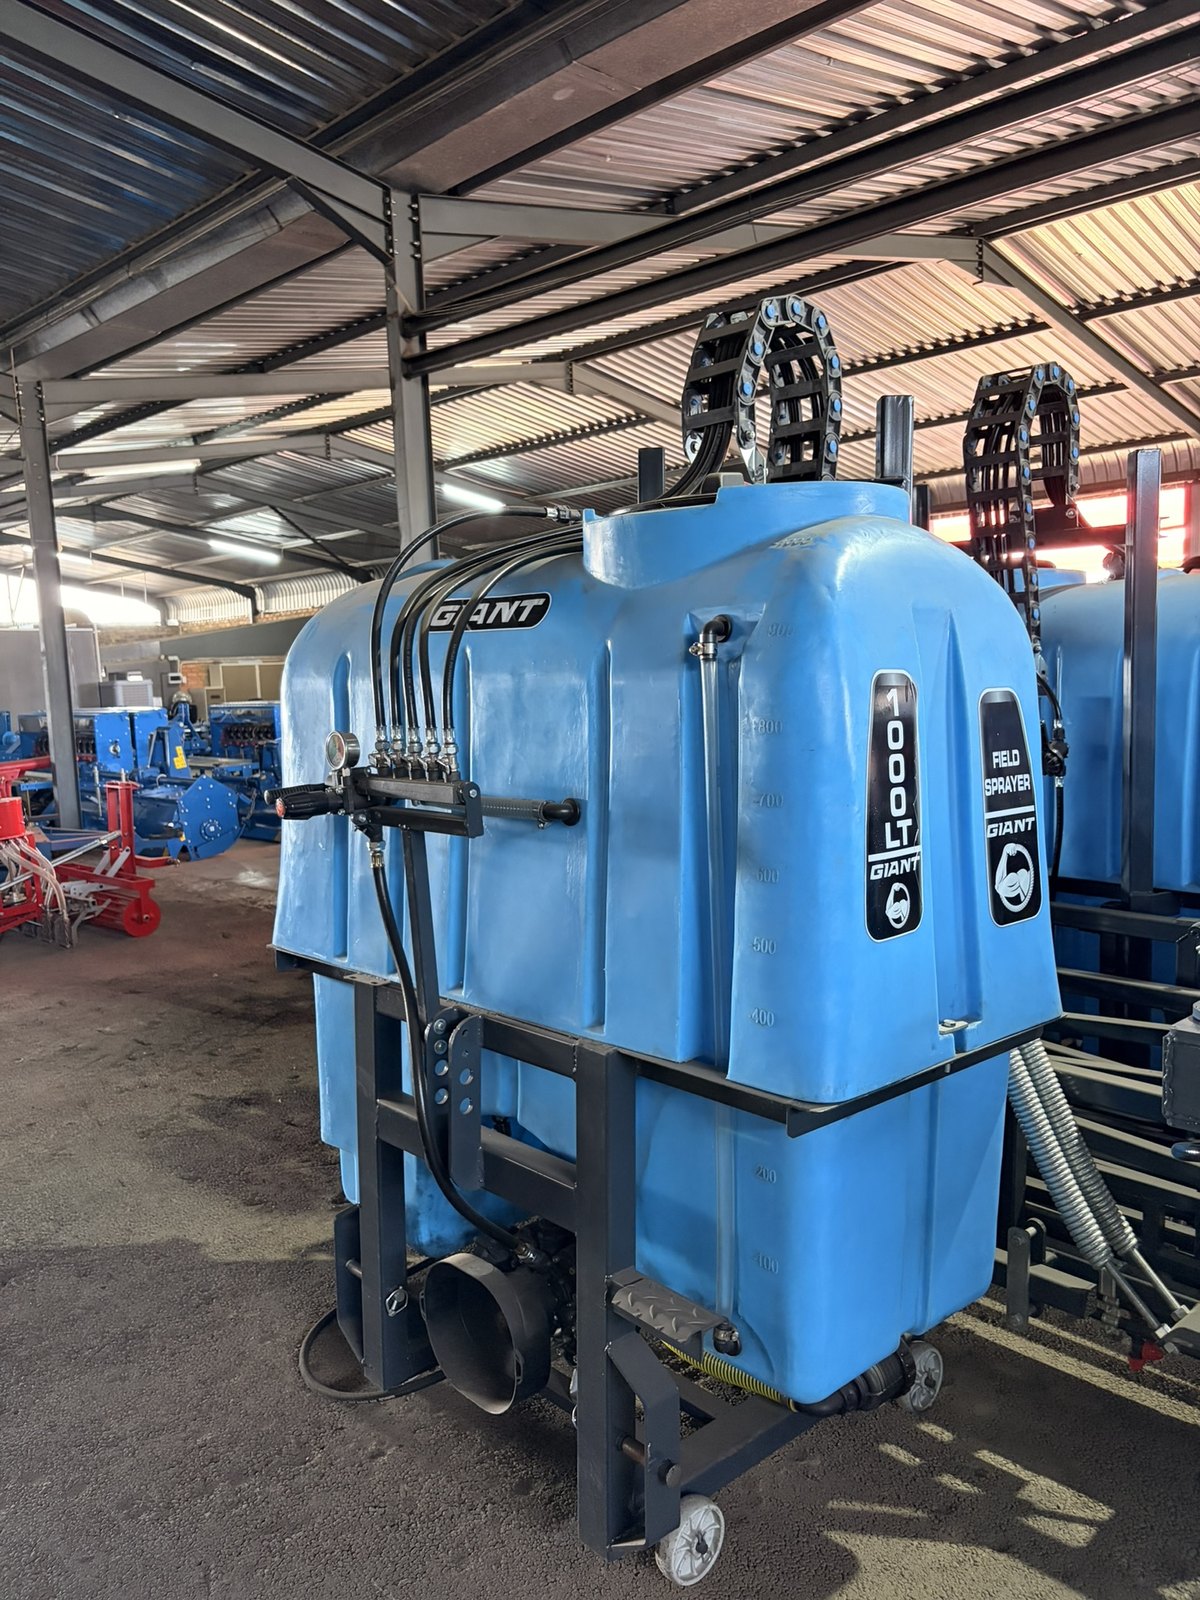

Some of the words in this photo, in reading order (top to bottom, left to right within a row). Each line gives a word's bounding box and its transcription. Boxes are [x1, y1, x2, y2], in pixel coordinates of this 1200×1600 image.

[430, 598, 546, 627] GANT
[758, 719, 783, 735] 800
[992, 749, 1020, 769] FIELD
[984, 773, 1031, 797] SPRAYER
[759, 793, 784, 808] 700
[986, 817, 1035, 838] GIANT
[870, 855, 920, 880] GIANT
[752, 936, 777, 955] 500
[751, 1007, 775, 1028] 400
